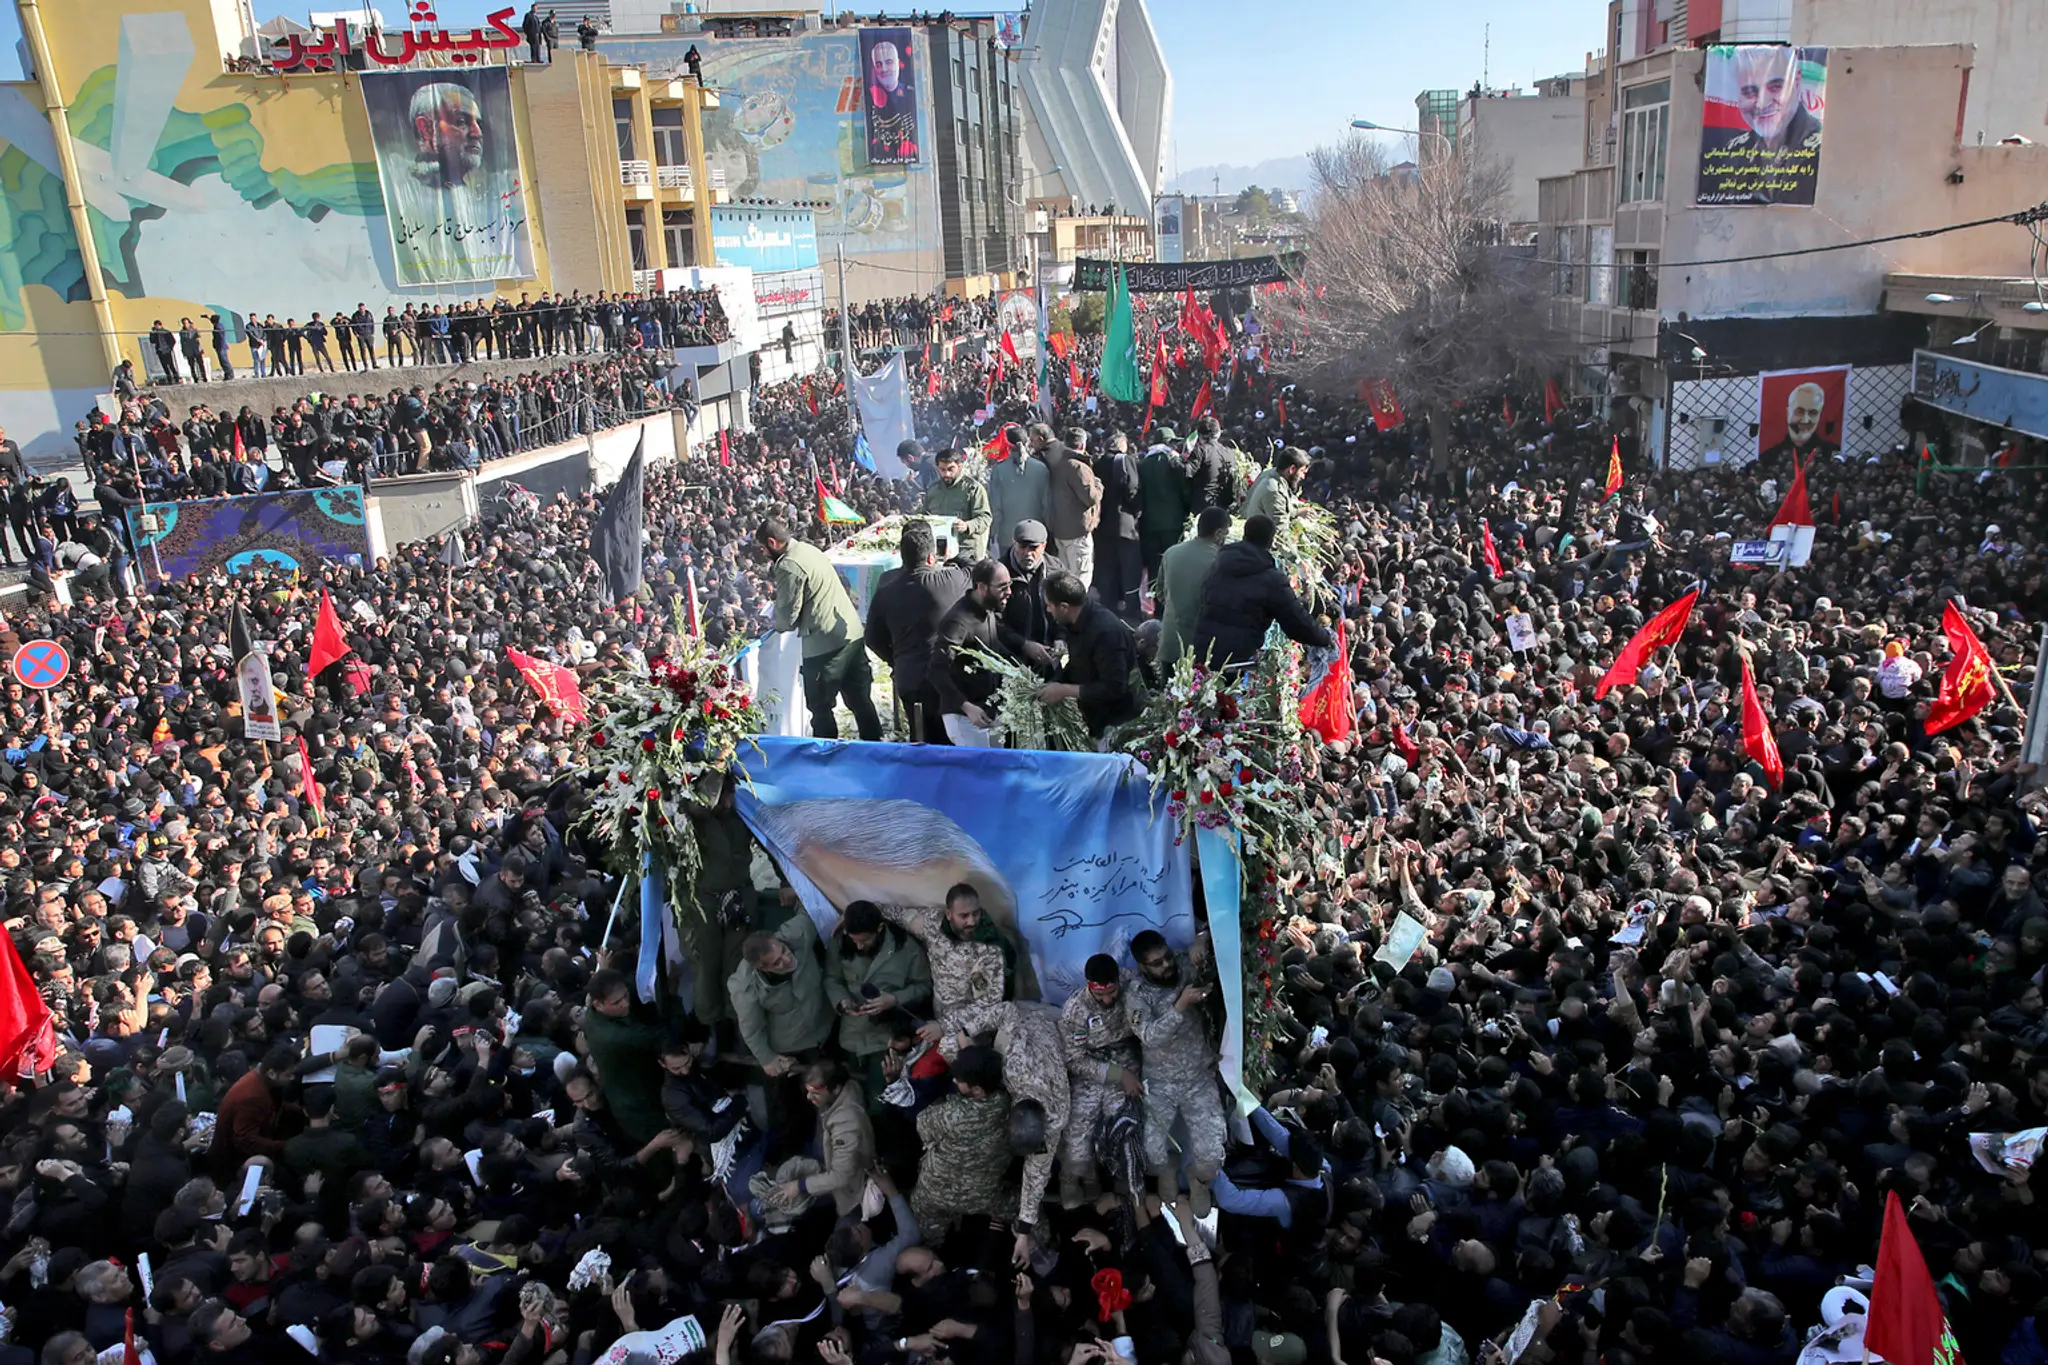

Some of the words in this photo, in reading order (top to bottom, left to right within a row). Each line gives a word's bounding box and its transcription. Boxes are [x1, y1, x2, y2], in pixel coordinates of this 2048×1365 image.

[272, 18, 349, 69] ایر
[365, 1, 521, 65] کیش
[1704, 148, 1730, 159] سلیمانی
[1799, 166, 1808, 174] به
[1808, 164, 1815, 175] را
[396, 216, 425, 251] سلیمانی
[428, 217, 452, 241] قاسم
[453, 223, 474, 242] حاج
[476, 219, 497, 244] سپهبد
[499, 216, 526, 235] سردار
